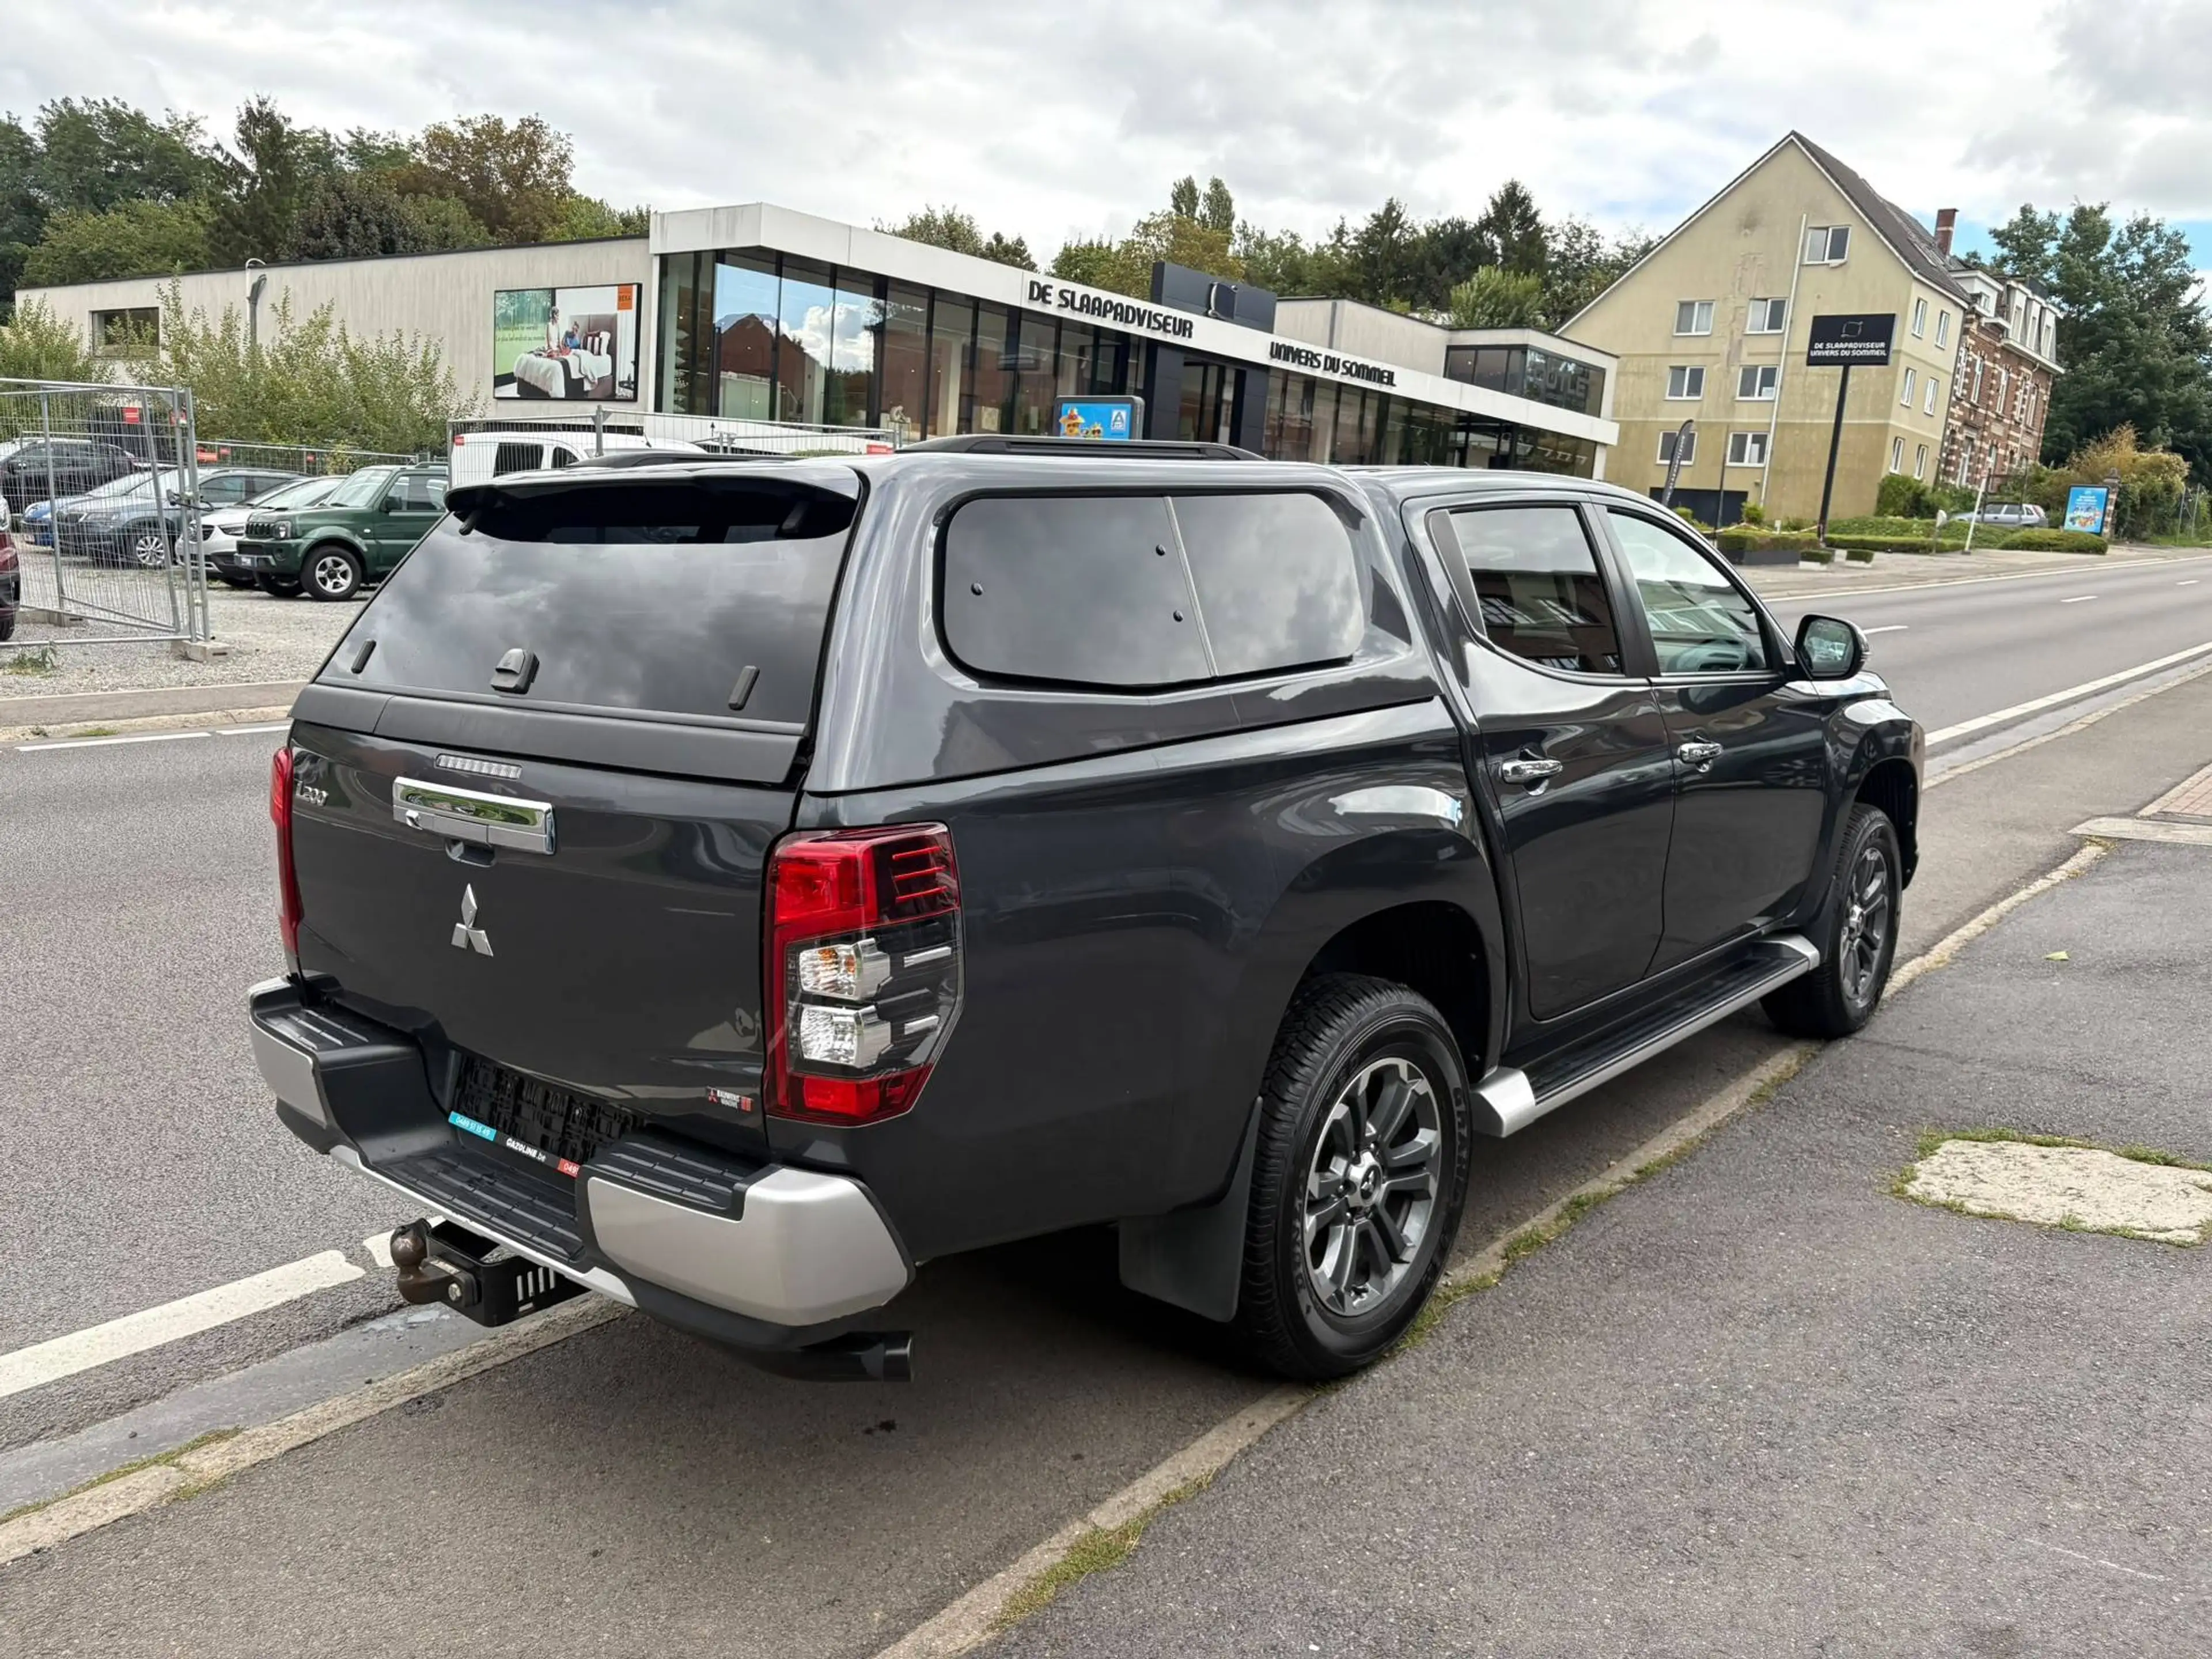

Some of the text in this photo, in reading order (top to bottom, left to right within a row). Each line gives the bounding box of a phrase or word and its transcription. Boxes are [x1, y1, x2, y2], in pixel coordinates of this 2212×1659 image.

[1028, 280, 1193, 338] DE SLAAPADVISEUR
[1270, 341, 1396, 387] UNIVERS DU SOMMEIL
[506, 1137, 547, 1162] GAZOLINE.be
